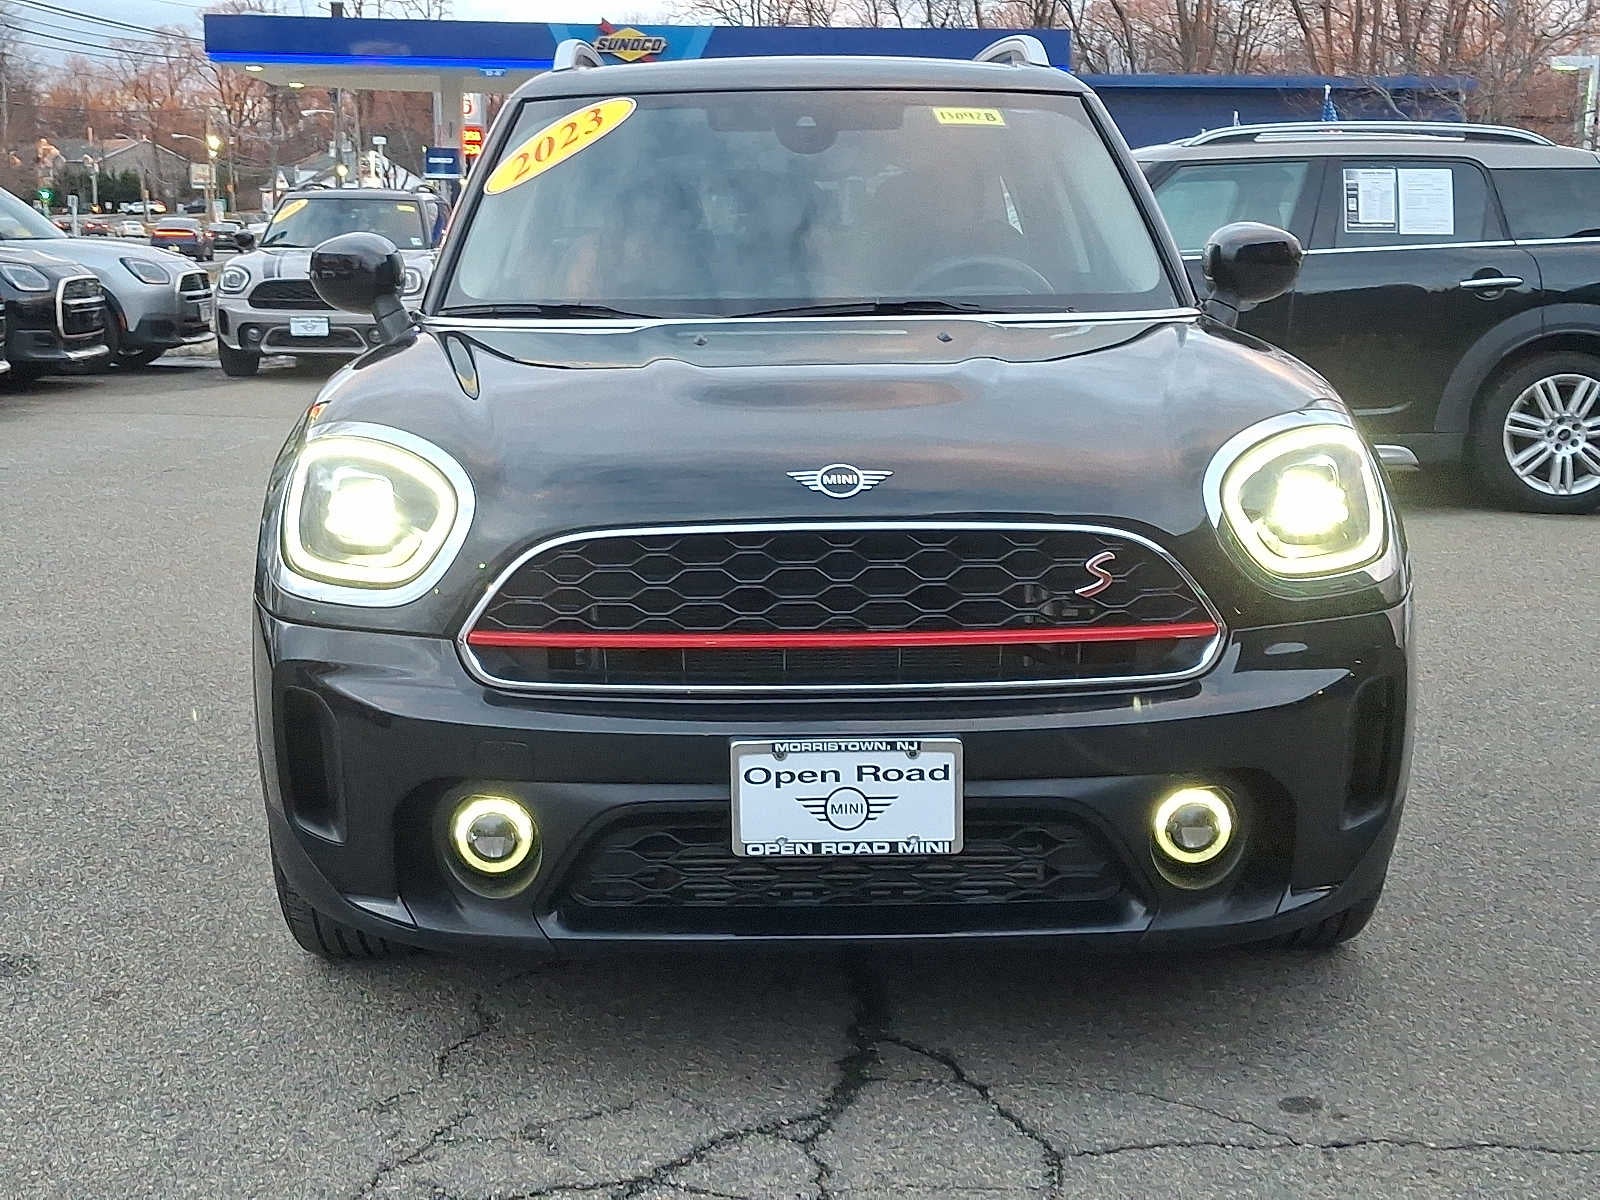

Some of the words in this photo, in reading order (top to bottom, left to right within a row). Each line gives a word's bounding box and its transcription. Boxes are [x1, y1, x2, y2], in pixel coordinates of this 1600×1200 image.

[597, 38, 662, 51] SUNOCO
[511, 107, 604, 183] 2023
[822, 474, 859, 485] MINI
[1074, 550, 1116, 598] S
[896, 741, 919, 751] NJ
[743, 766, 841, 789] Open
[856, 763, 950, 783] Road
[830, 802, 864, 815] MINI
[746, 842, 814, 856] OPEN
[820, 841, 891, 855] ROAD
[897, 840, 950, 854] MINI
